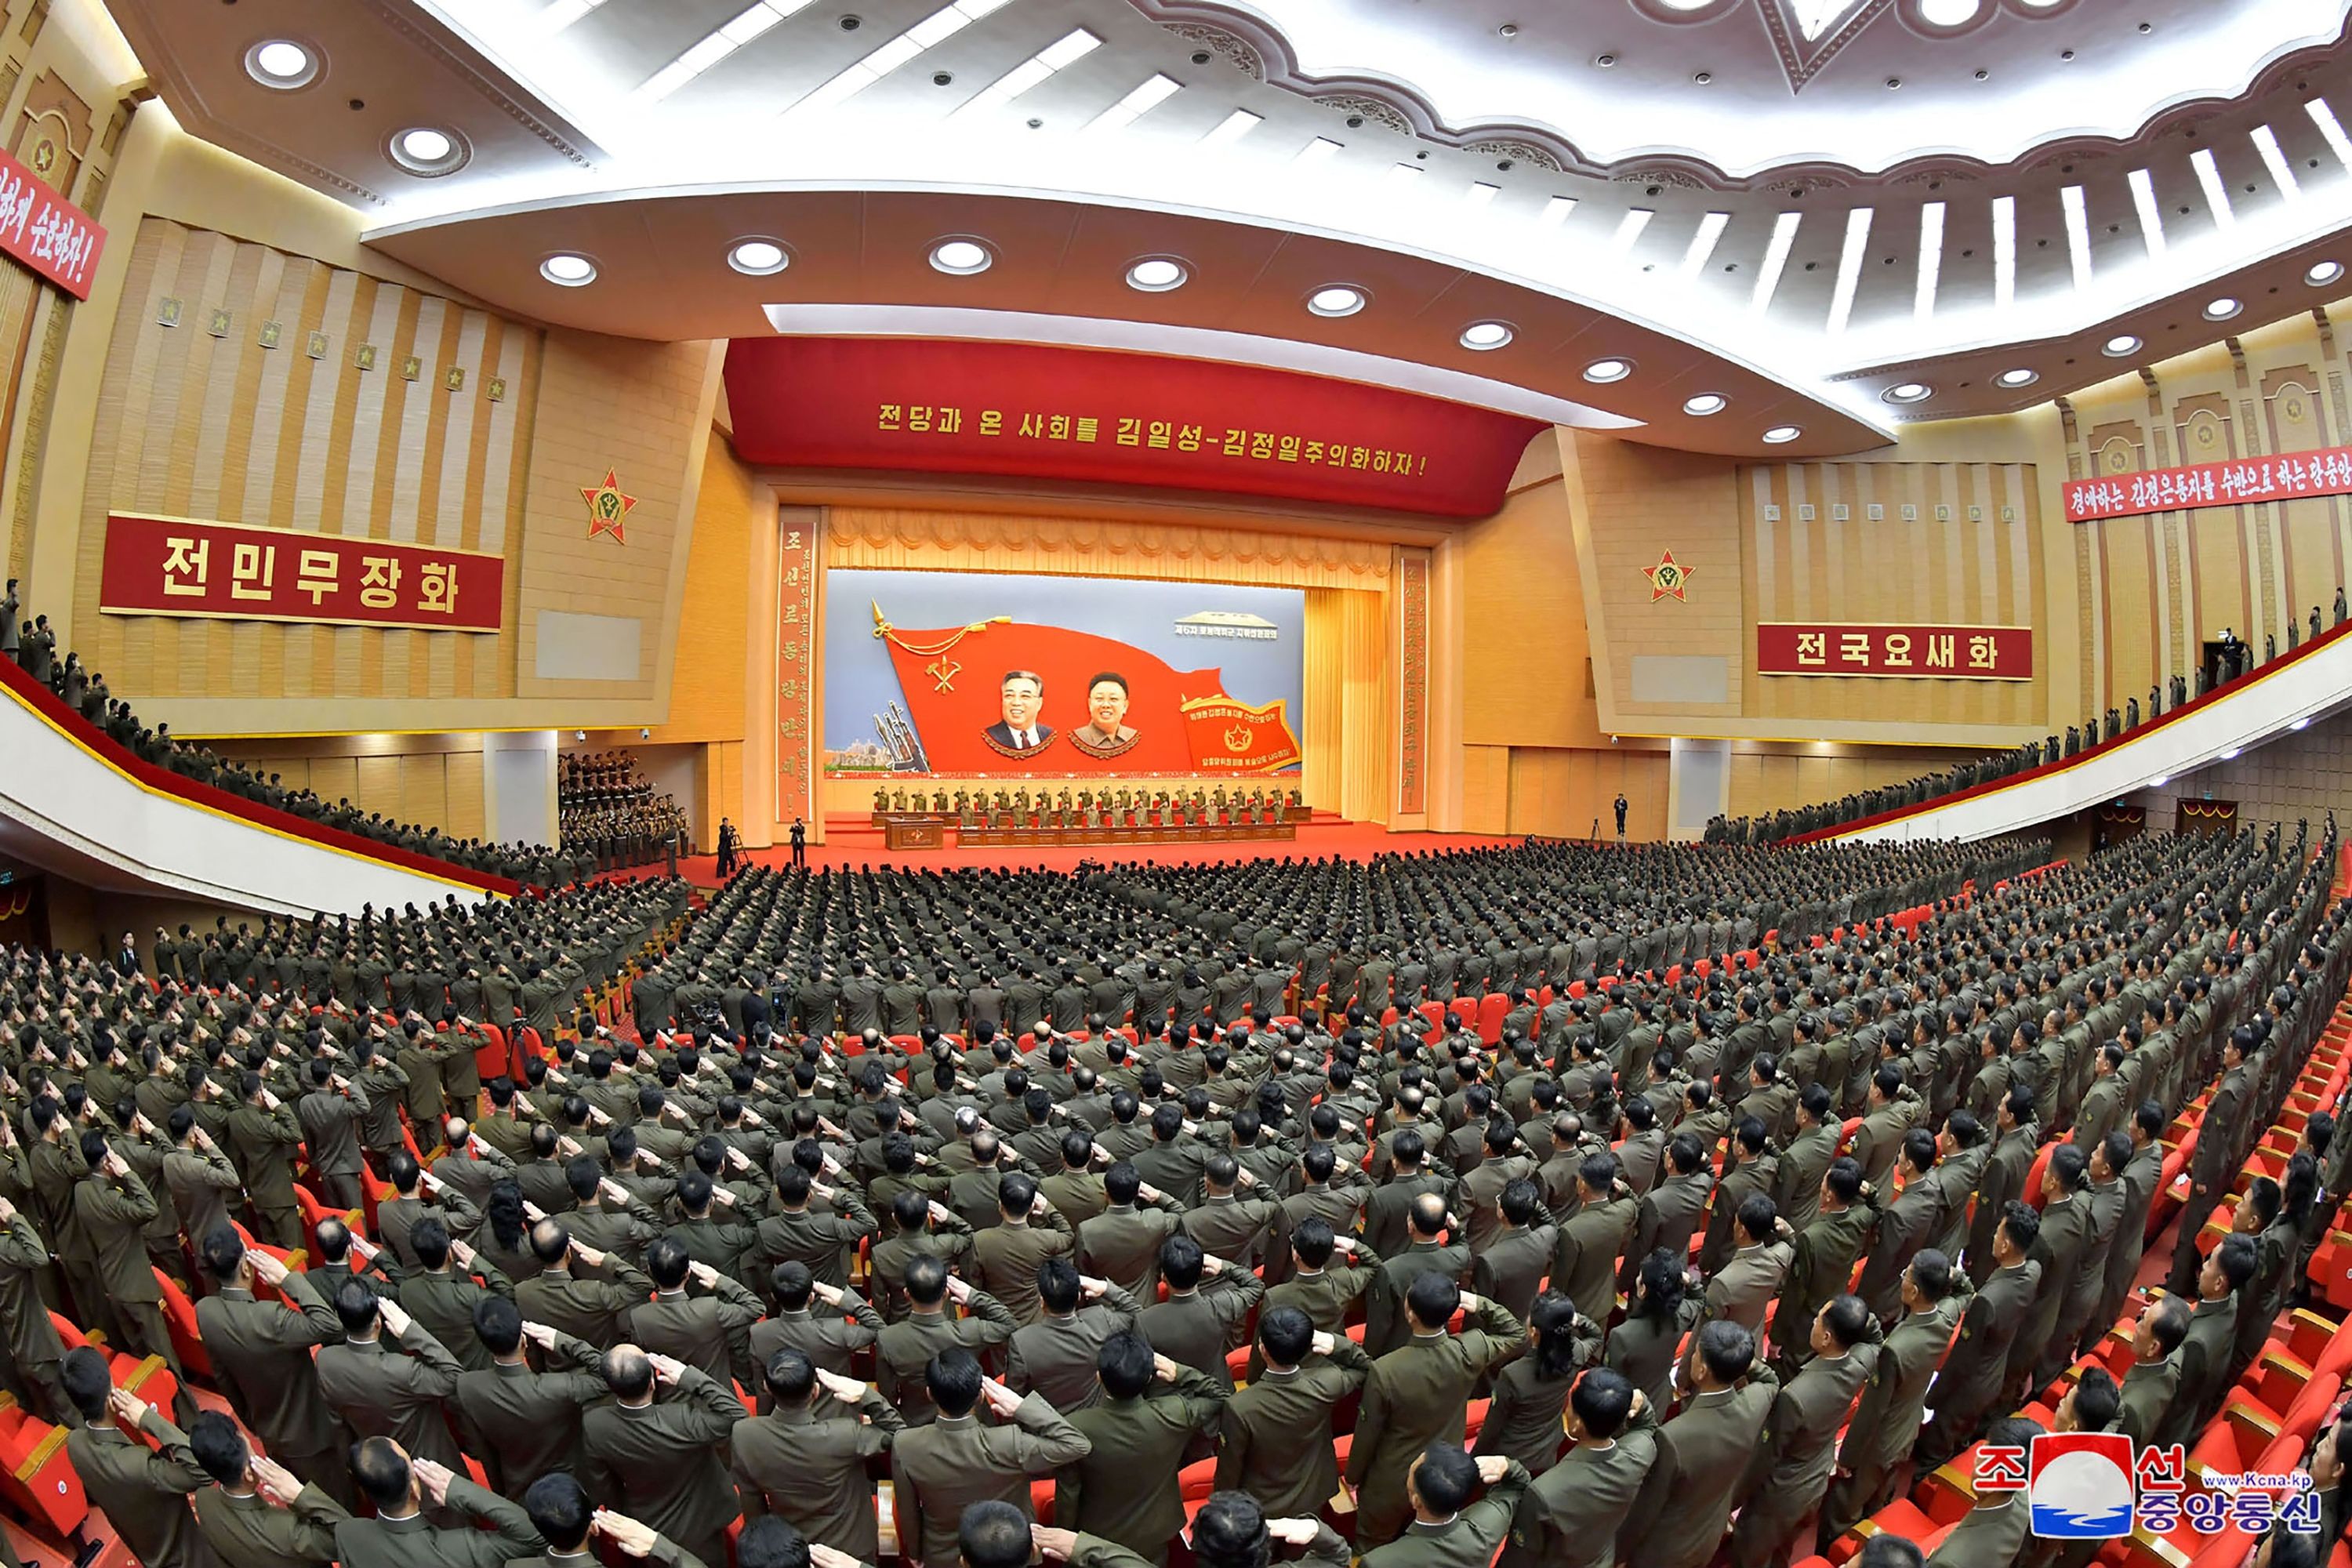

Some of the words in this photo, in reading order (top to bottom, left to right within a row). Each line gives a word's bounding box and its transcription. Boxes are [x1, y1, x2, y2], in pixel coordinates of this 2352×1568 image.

[0, 166, 35, 245] 하게
[31, 201, 93, 284] 수호하자!
[879, 405, 962, 433] 전당과
[979, 410, 1002, 436] 온
[1018, 413, 1098, 442] 사회를
[1116, 418, 1427, 476] 김일성-김정일주의화하자!
[2071, 481, 2125, 515] 경애하는
[2130, 470, 2216, 508] 김정은동지를
[2220, 464, 2275, 499] 수반으로
[2276, 459, 2307, 492] 하는
[162, 537, 459, 613] 전민무장화
[1796, 633, 1998, 671] 전국요새화
